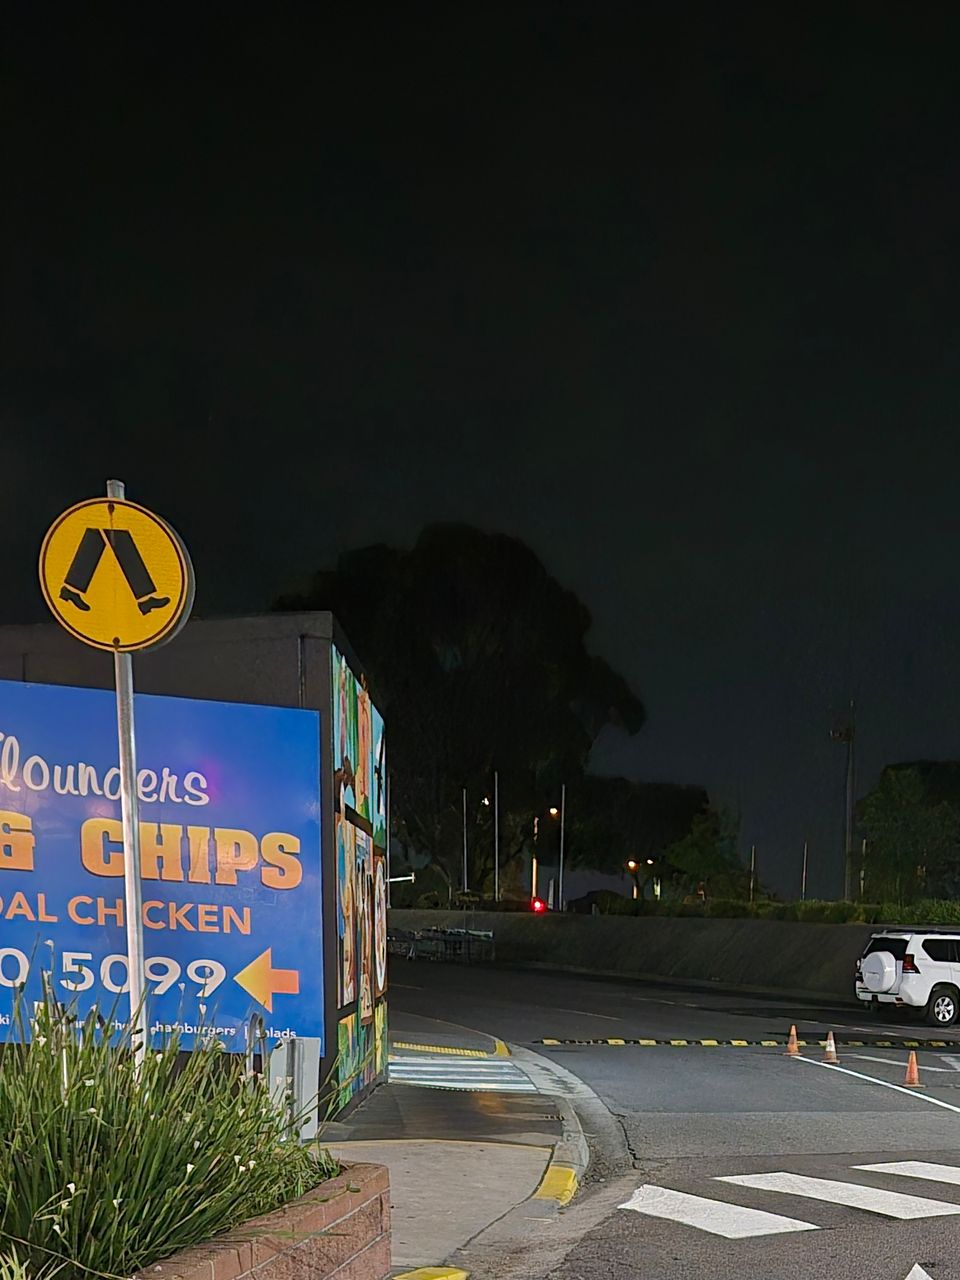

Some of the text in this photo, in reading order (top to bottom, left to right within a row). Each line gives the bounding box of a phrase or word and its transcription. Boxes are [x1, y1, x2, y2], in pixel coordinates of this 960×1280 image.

[0, 732, 210, 806] louners
[81, 817, 303, 890] CHIPS
[67, 896, 251, 935] CHCKEN
[60, 951, 227, 998] 5099
